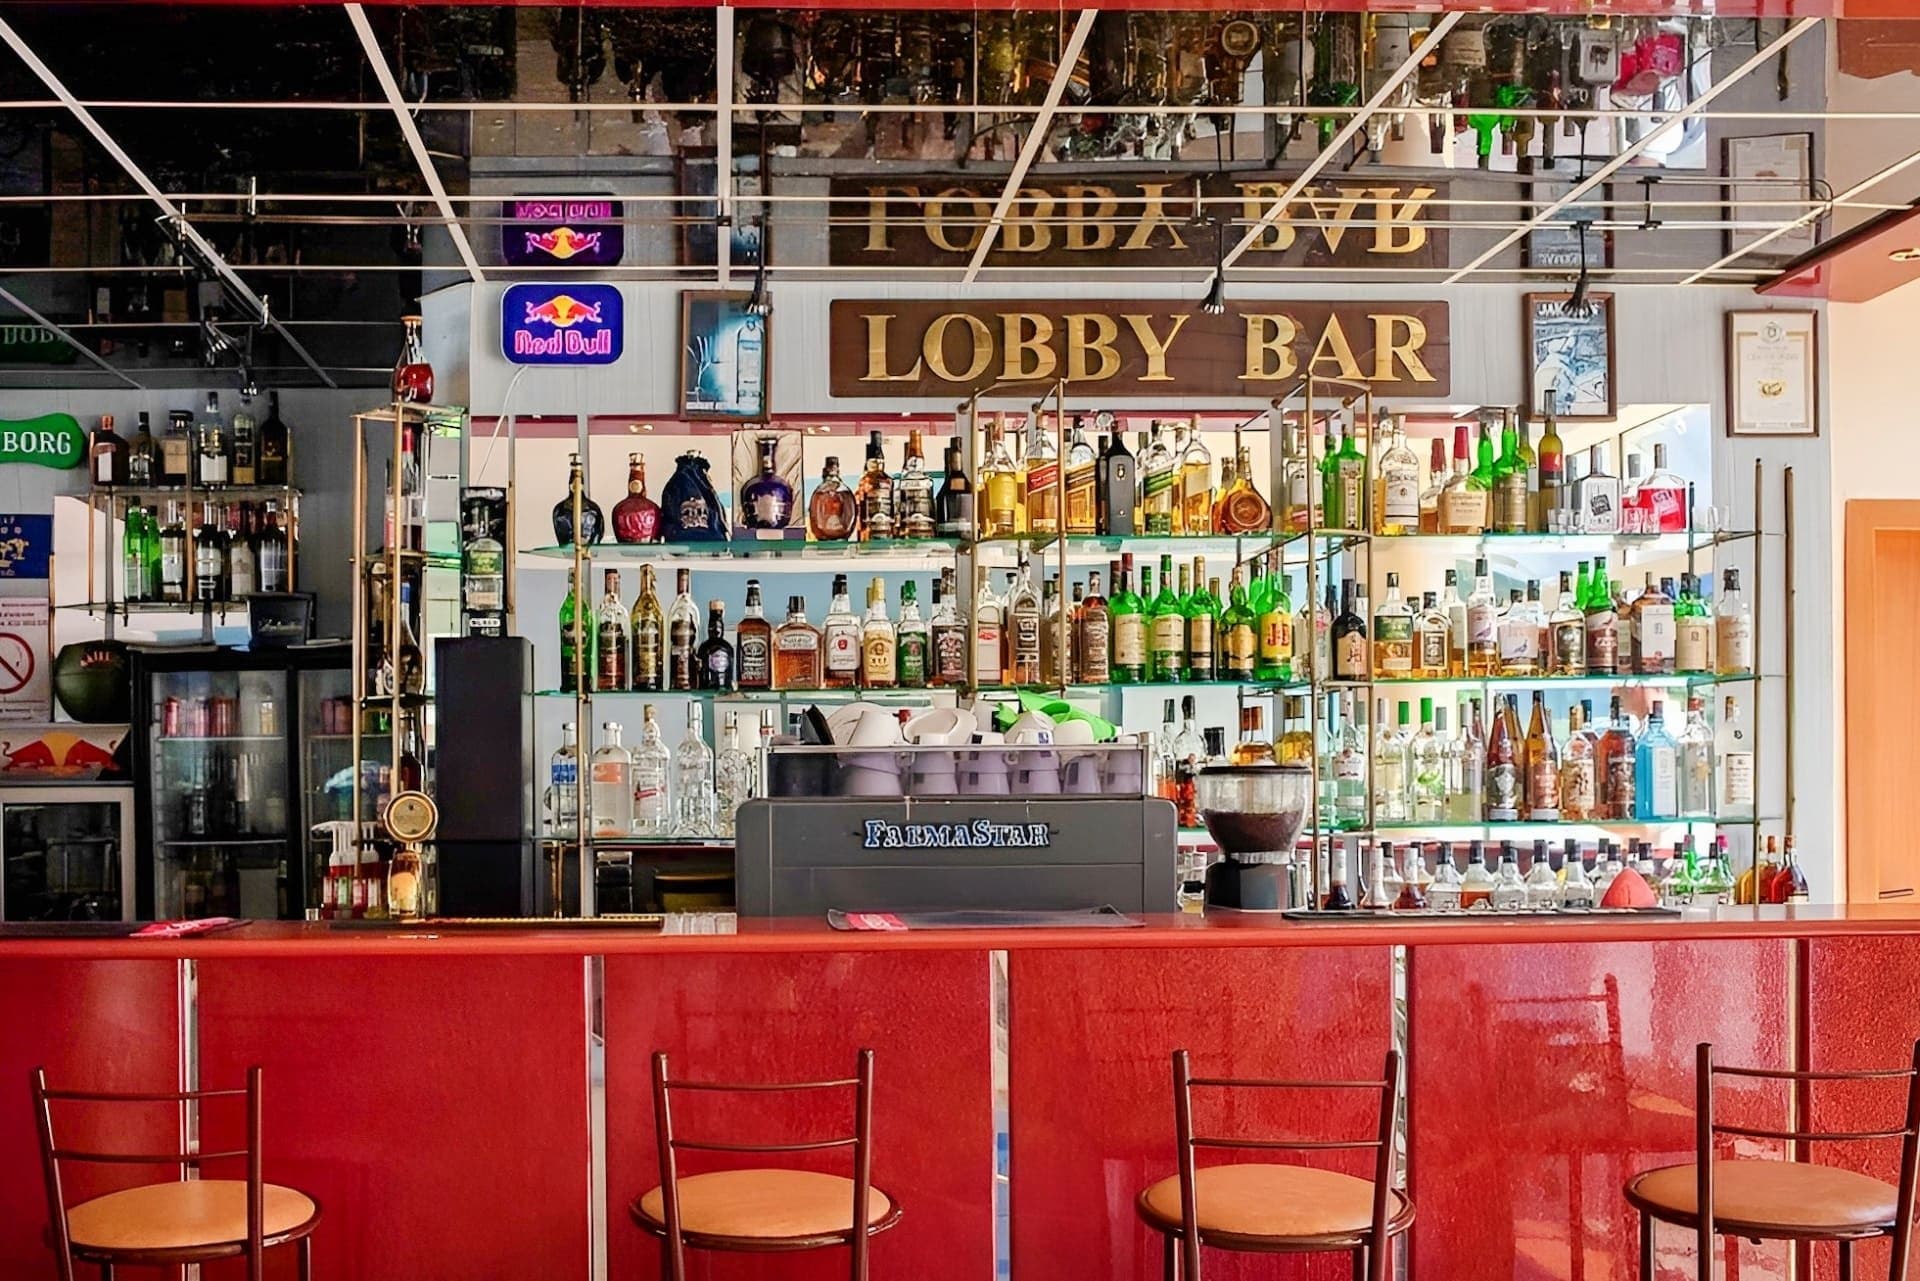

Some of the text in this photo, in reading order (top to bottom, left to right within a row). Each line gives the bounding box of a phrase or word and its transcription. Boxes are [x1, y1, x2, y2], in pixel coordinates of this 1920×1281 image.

[514, 328, 612, 355] Red Bull
[859, 312, 1438, 382] LOBBY BAR
[2, 431, 72, 455] BORG
